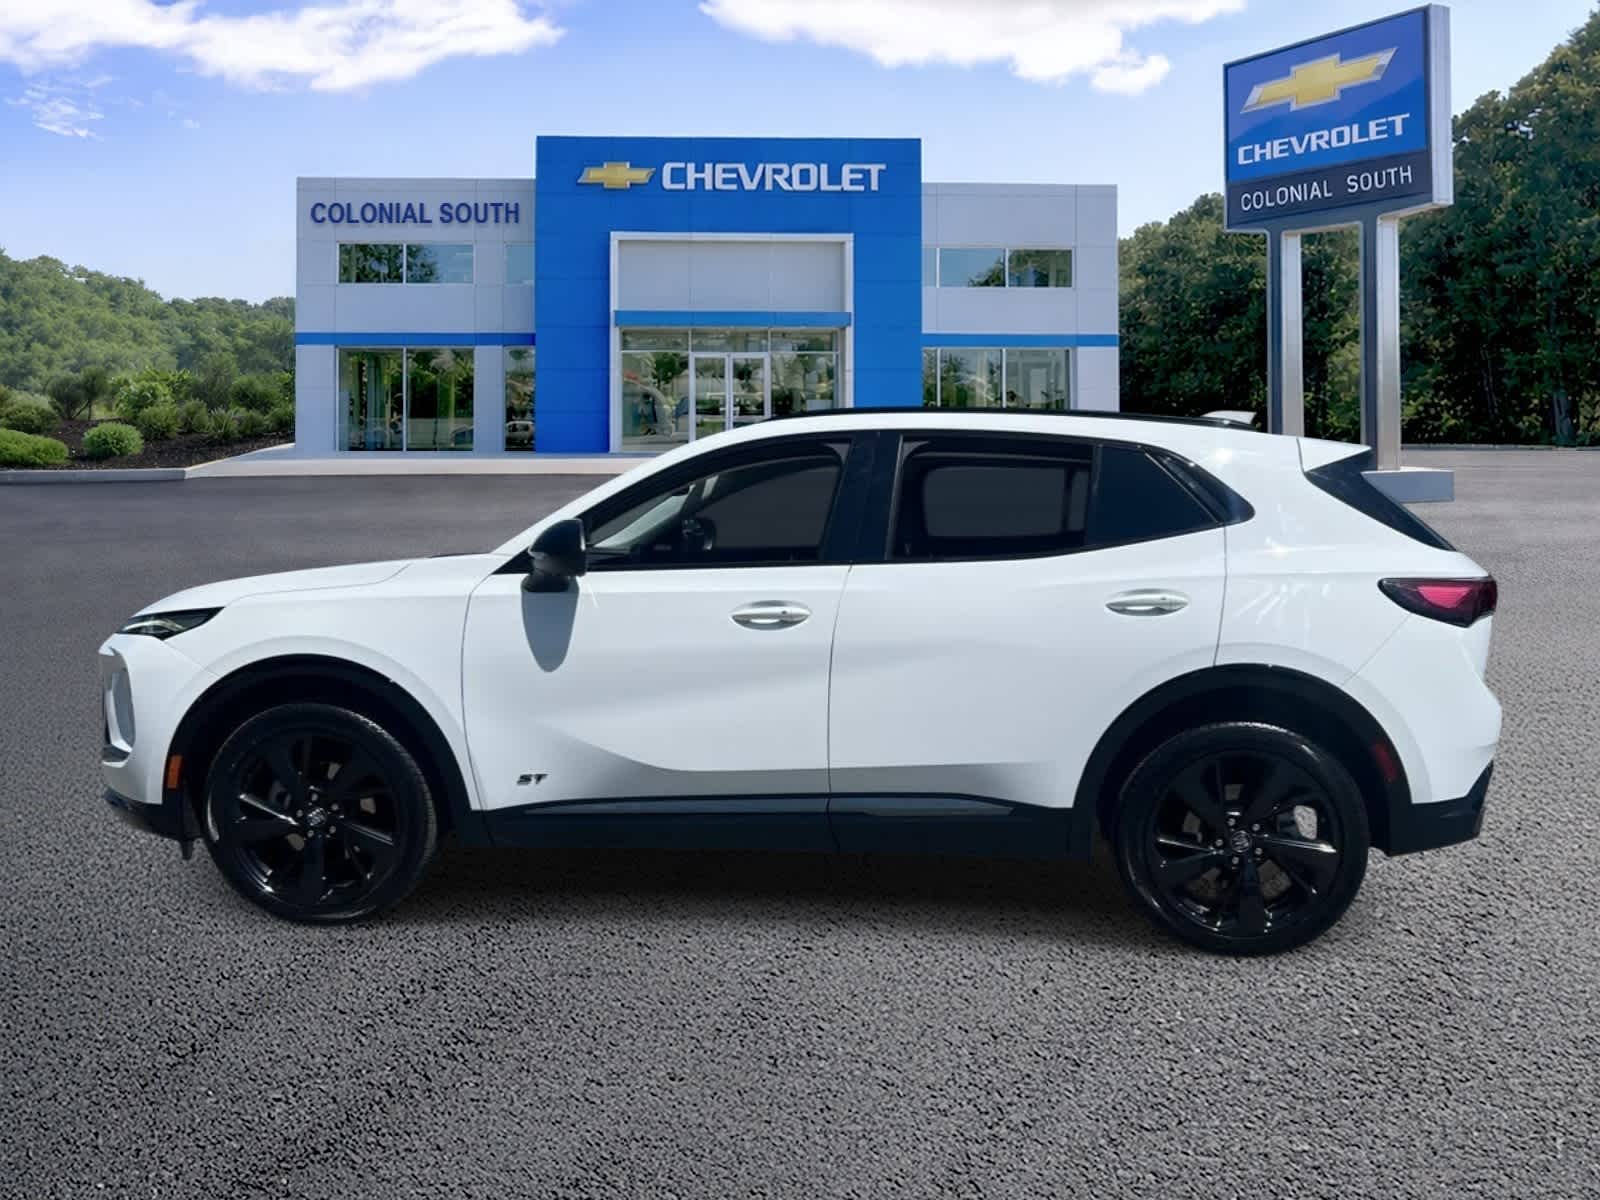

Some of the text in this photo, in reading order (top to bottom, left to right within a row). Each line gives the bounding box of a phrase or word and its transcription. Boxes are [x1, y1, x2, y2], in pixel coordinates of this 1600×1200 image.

[1237, 113, 1410, 165] CHEVROLET
[662, 161, 886, 193] CHEVROLET
[1240, 165, 1413, 211] COLONIAL SOUTH
[311, 202, 521, 224] COLONIAL SOUTH
[516, 773, 549, 786] ST
